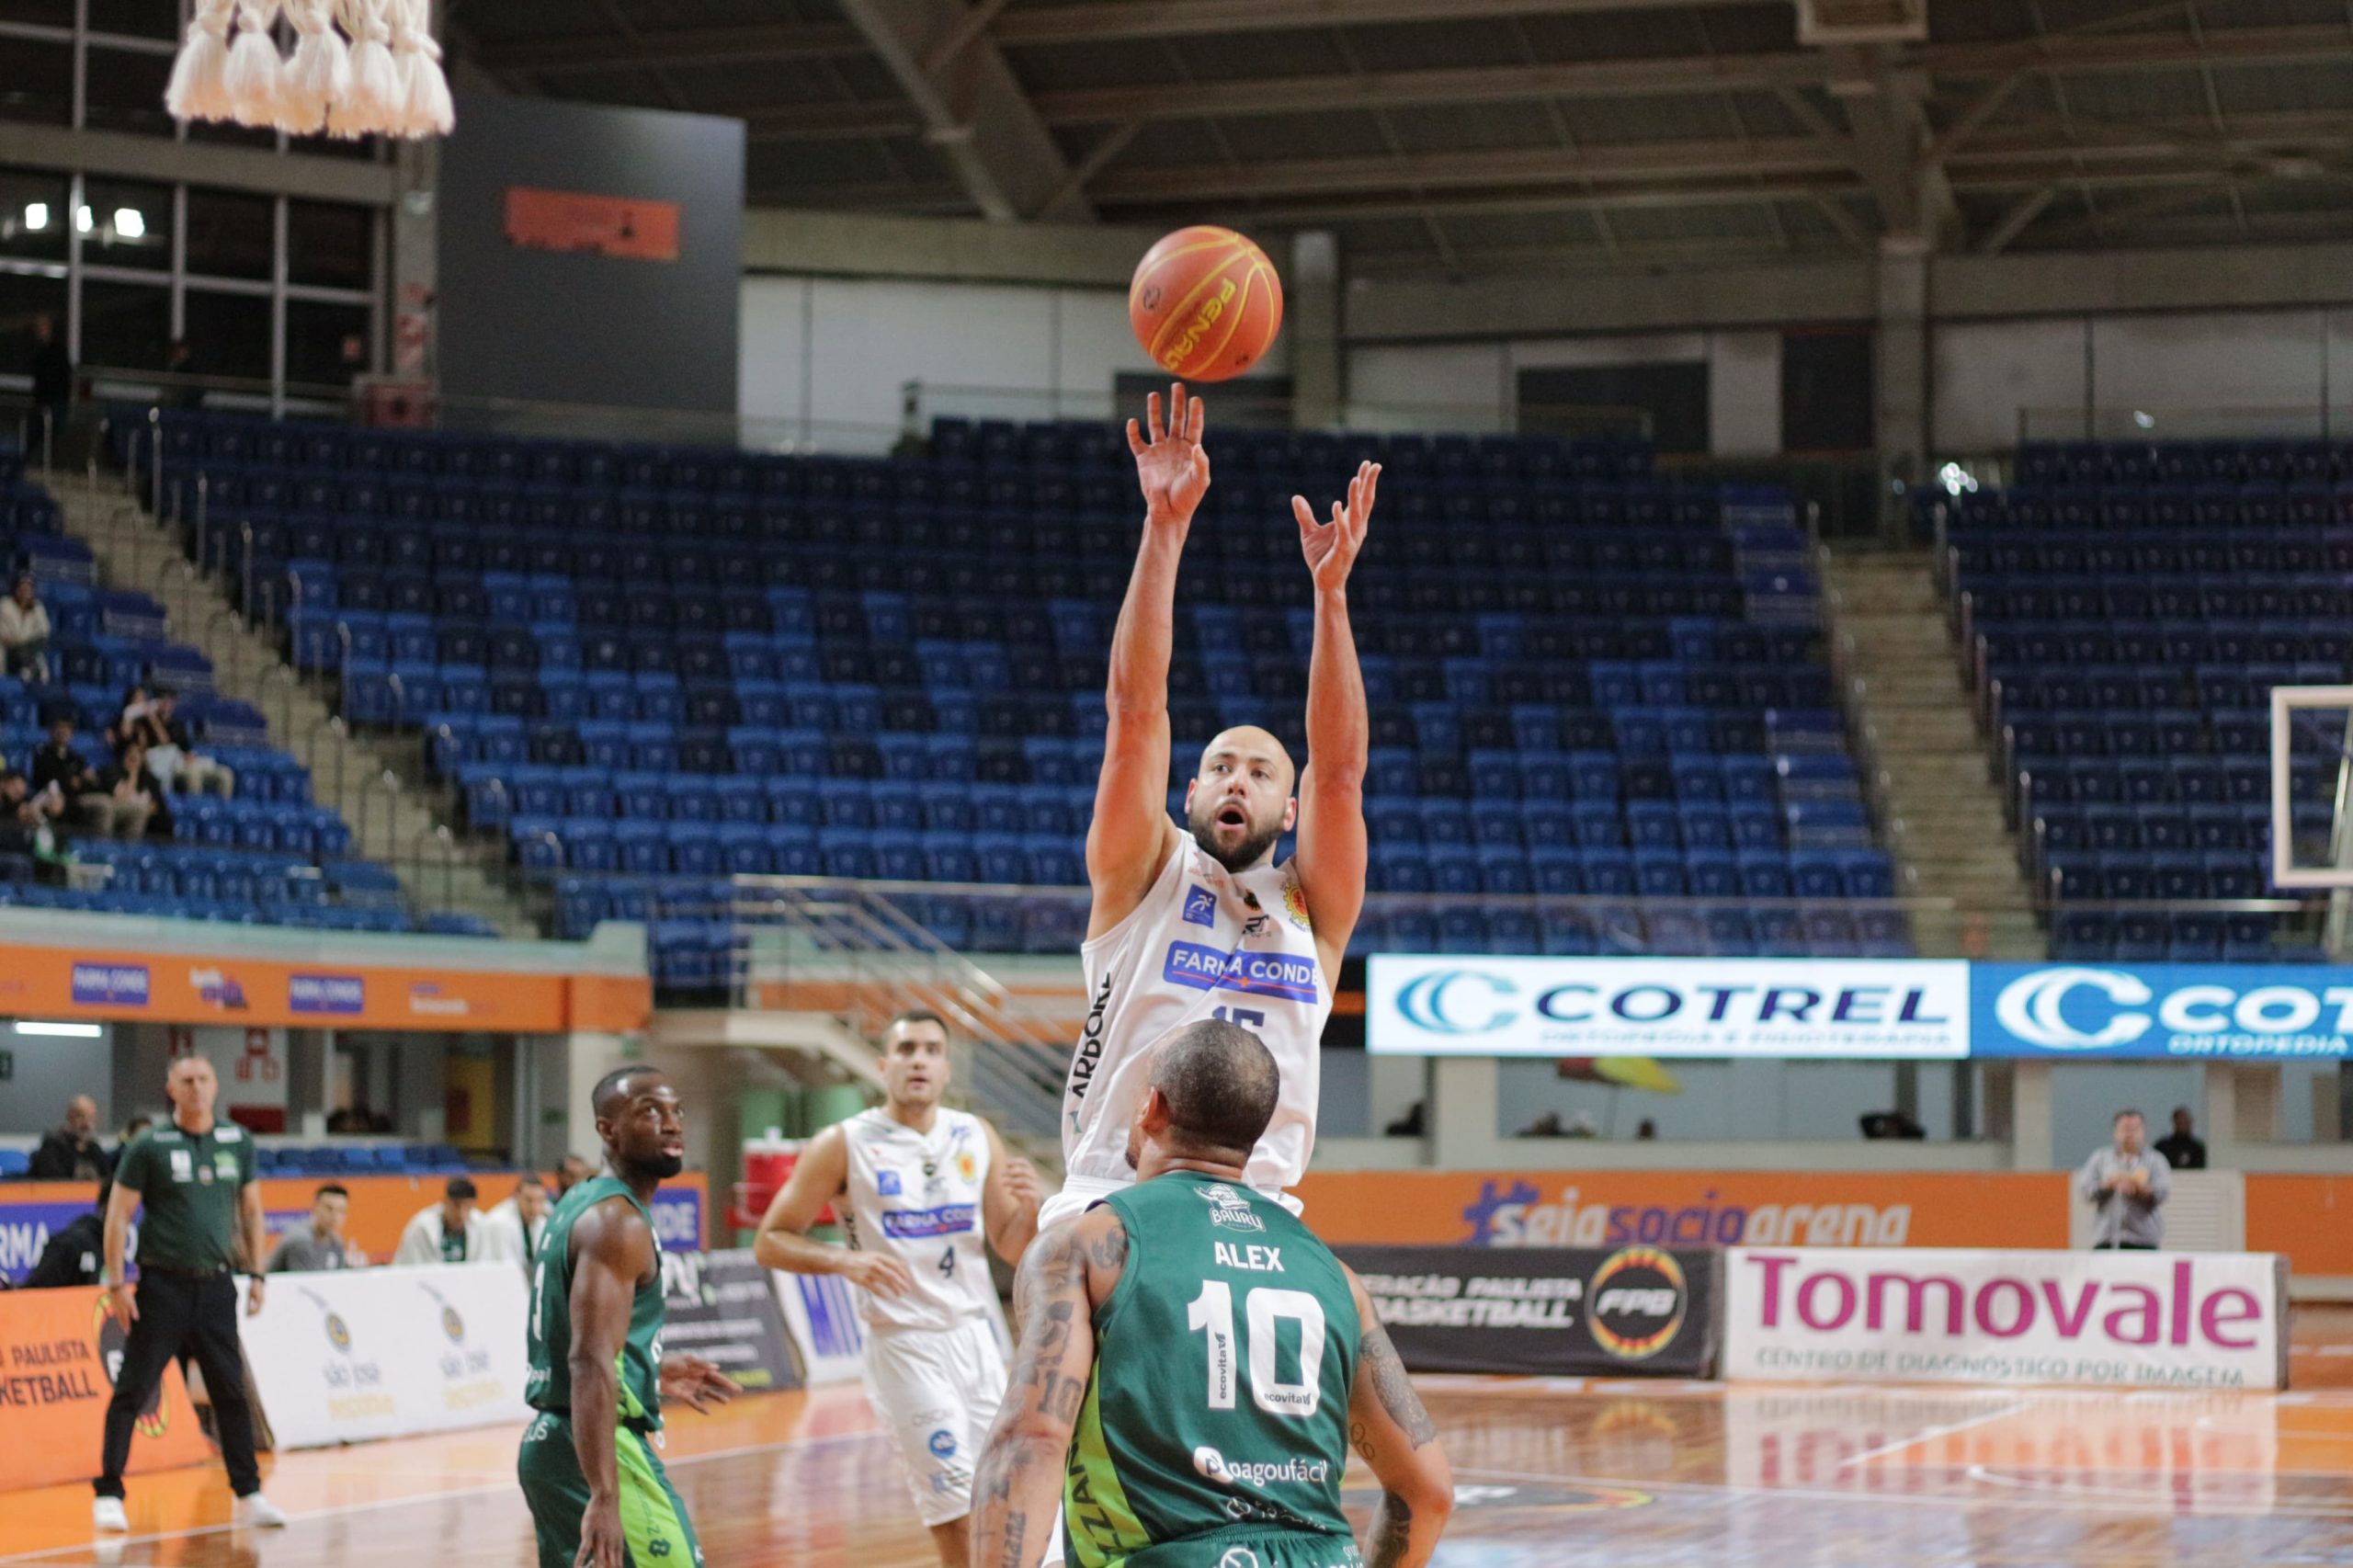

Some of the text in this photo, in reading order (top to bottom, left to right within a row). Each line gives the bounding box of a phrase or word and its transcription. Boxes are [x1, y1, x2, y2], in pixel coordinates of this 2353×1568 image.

[1164, 278, 1236, 371] PENALT
[1172, 949, 1243, 976] FARMA
[1536, 983, 1948, 1022] COTREL
[2167, 1033, 2349, 1055] ORTOPEDIA
[1211, 1209, 1264, 1229] BAURU
[938, 1245, 955, 1278] 4
[1214, 1241, 1285, 1272] ALEX
[1465, 1277, 1583, 1301] PAULISTA
[1596, 1288, 1677, 1316] FPB
[1745, 1256, 2261, 1349] Tomovale
[11, 1339, 91, 1367] PAULISTA
[1188, 1278, 1325, 1416] 10
[1755, 1346, 1852, 1369] CENTRO
[1859, 1349, 1888, 1369] DE
[2075, 1358, 2128, 1381] POR
[2135, 1364, 2245, 1387] IMAGEM
[1229, 1459, 1328, 1487] pagoufácil
